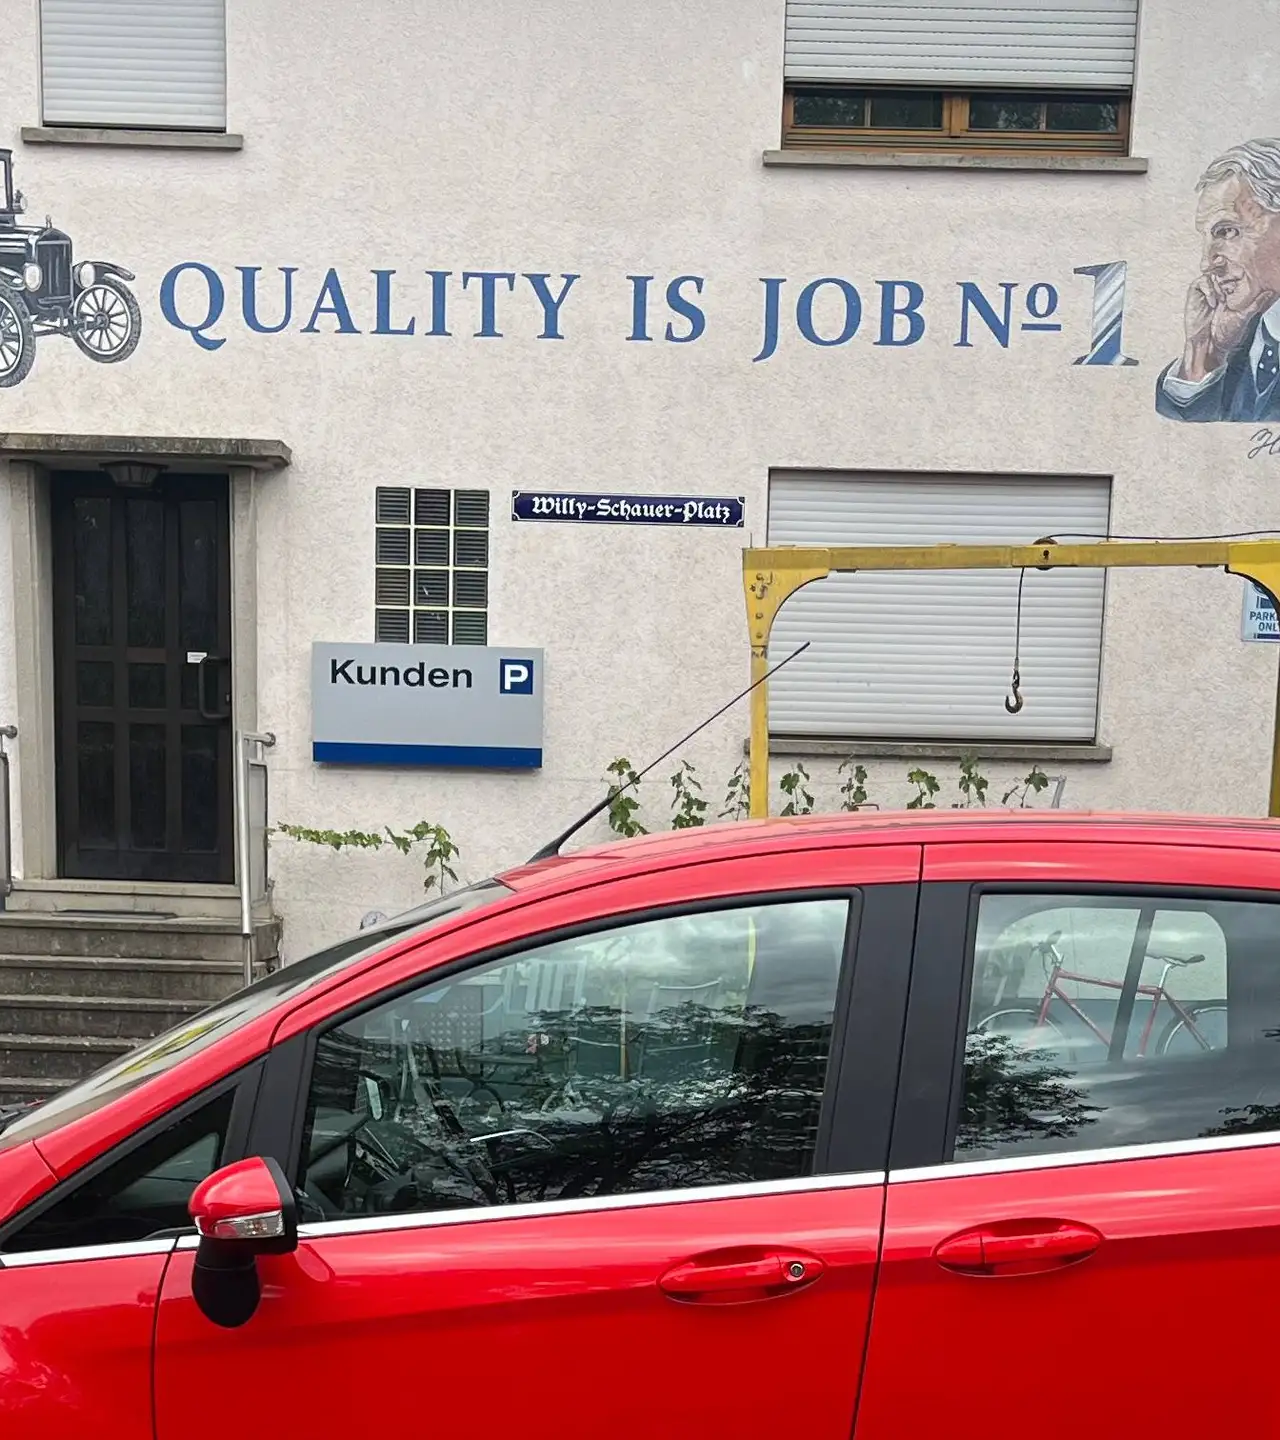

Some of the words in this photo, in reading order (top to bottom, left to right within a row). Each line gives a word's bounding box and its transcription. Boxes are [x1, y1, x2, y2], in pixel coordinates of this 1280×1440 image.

[159, 262, 580, 351] QUALITY
[626, 275, 706, 344] IS
[752, 277, 927, 365] JOB
[1071, 260, 1139, 366] 1
[531, 496, 731, 523] Willy-Schauer-Platz
[1258, 622, 1278, 632] ONL
[330, 658, 473, 688] Kunden
[503, 664, 529, 690] P
